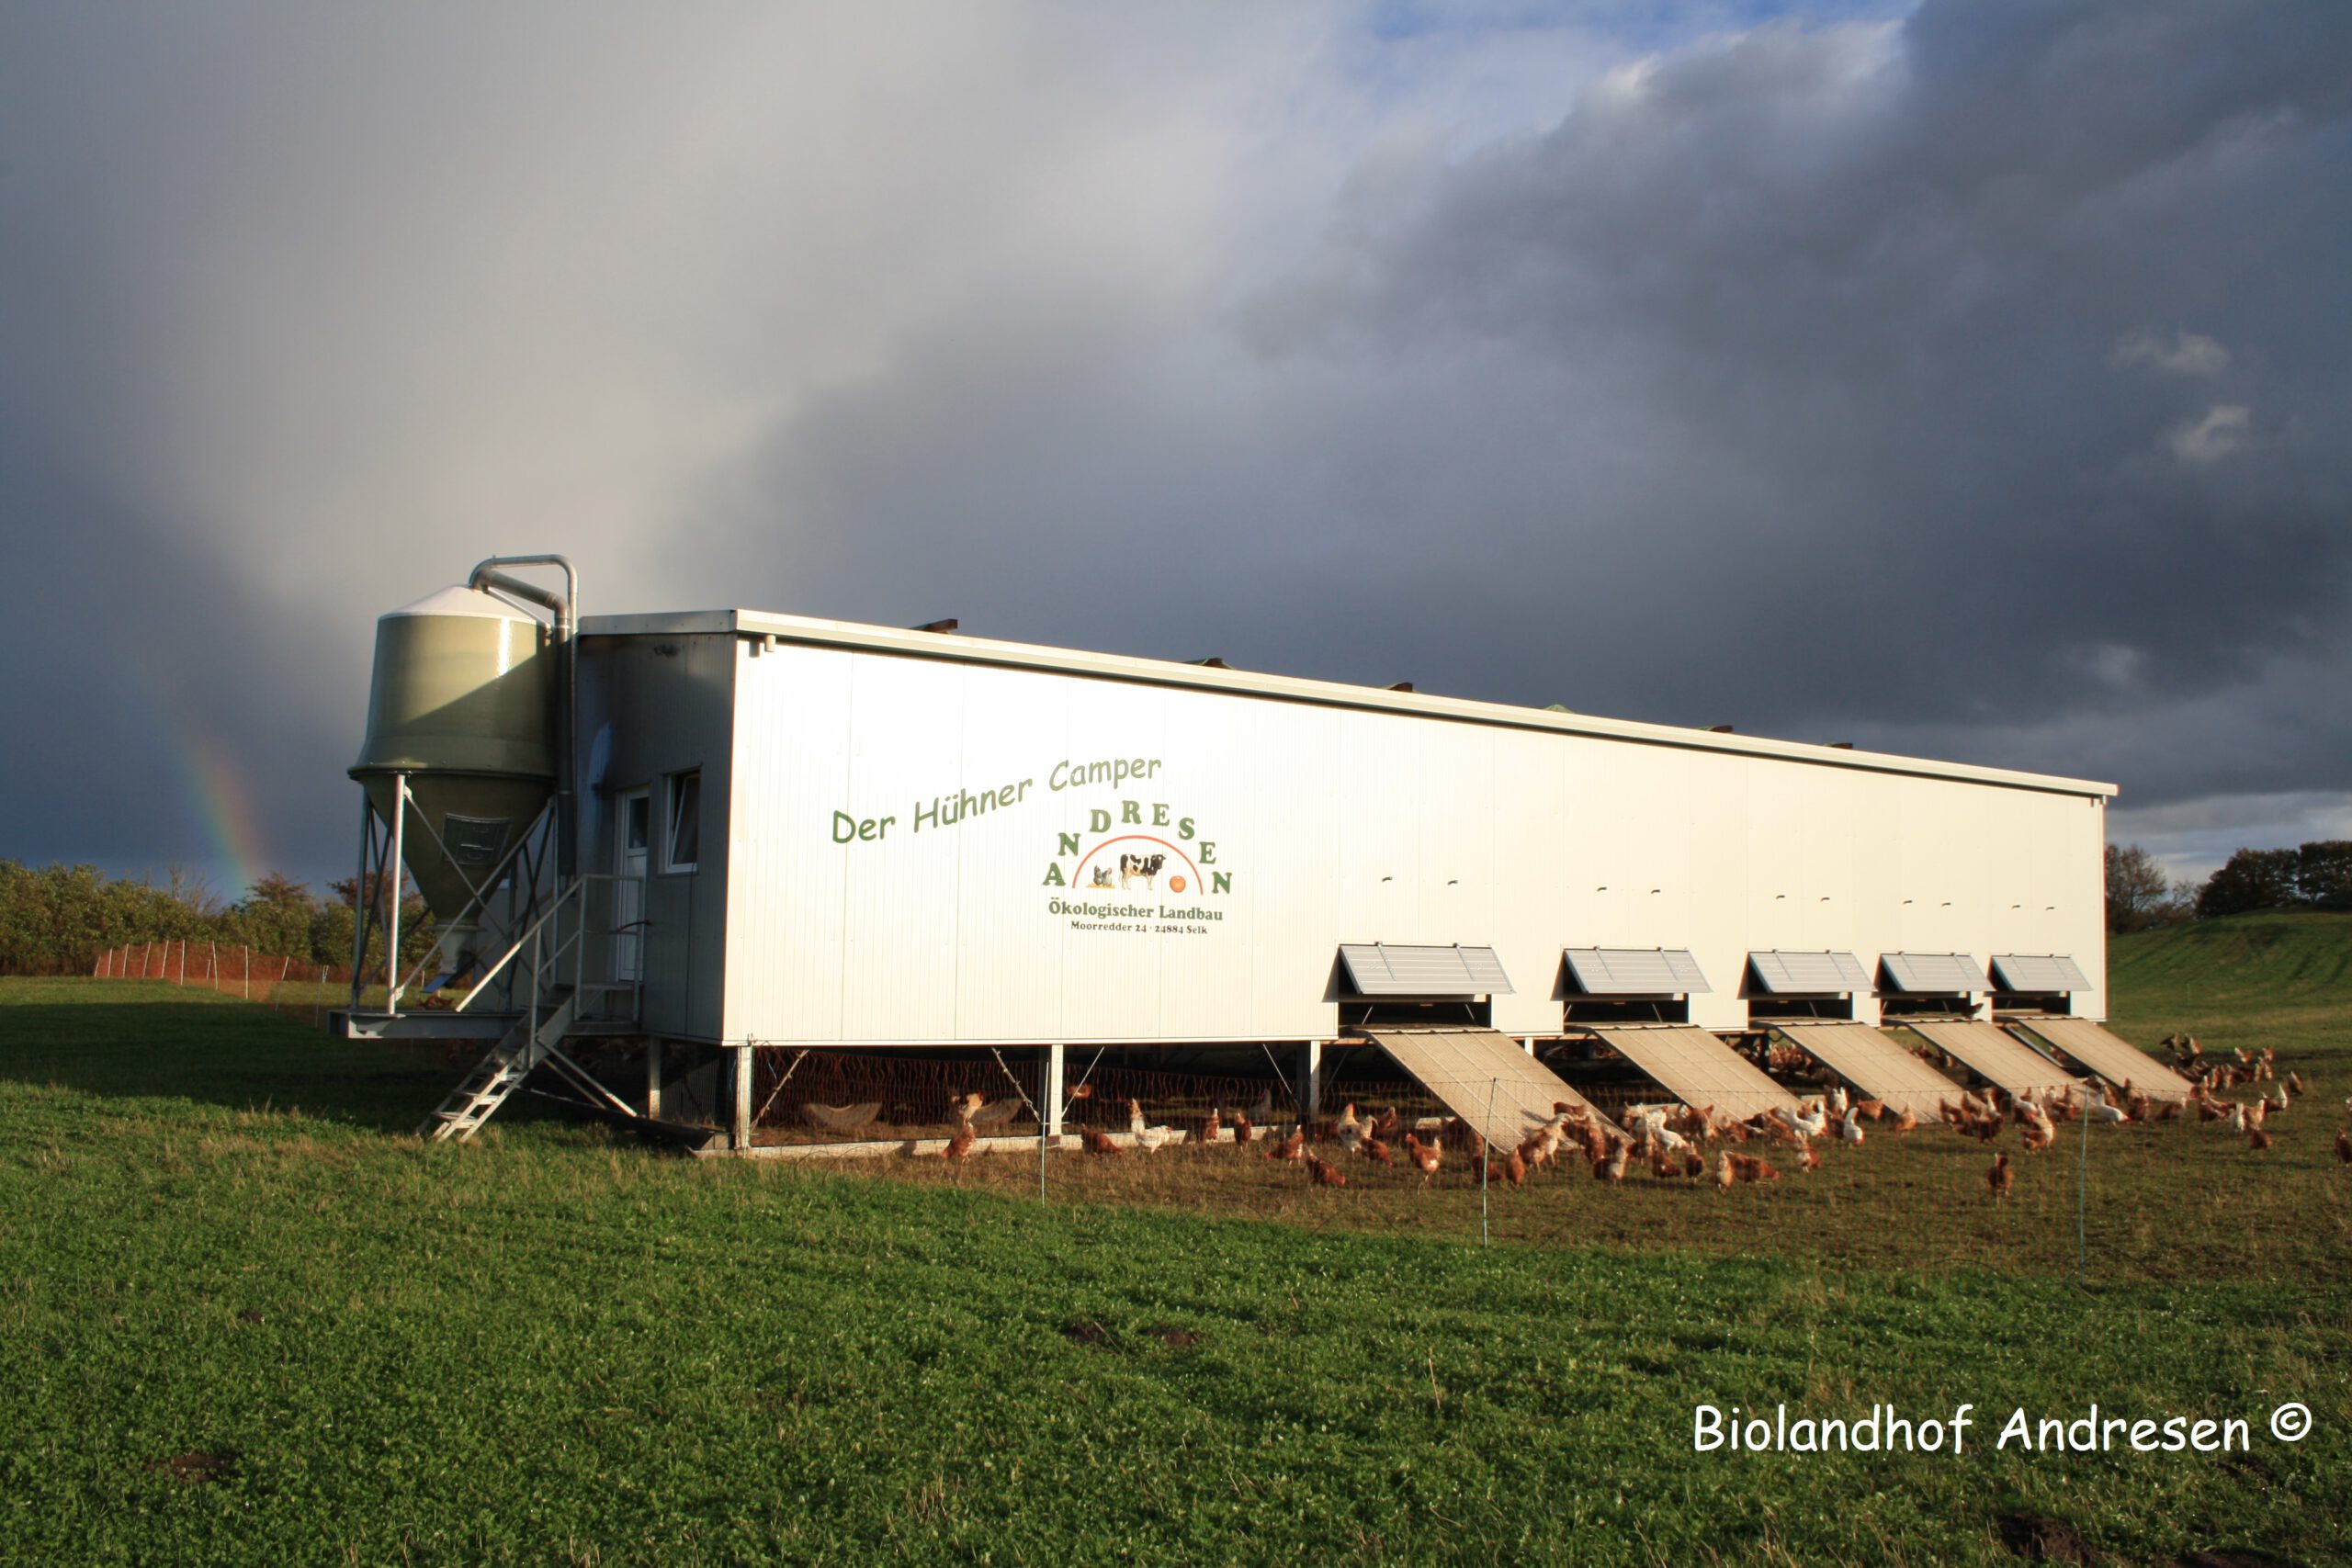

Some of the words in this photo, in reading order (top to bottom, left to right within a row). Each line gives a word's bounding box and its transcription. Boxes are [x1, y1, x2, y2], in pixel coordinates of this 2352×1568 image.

[831, 810, 896, 844] Der
[913, 778, 1034, 833] Hühner
[1048, 758, 1162, 792] Camper
[1042, 800, 1233, 895] ANDRESEN
[1048, 897, 1154, 919] Ökologischer
[1159, 905, 1223, 921] Landbau
[1071, 920, 1132, 931] Moorredder
[1135, 924, 1147, 933] 24
[1155, 924, 1183, 934] 24884
[1186, 925, 1208, 934] Selk
